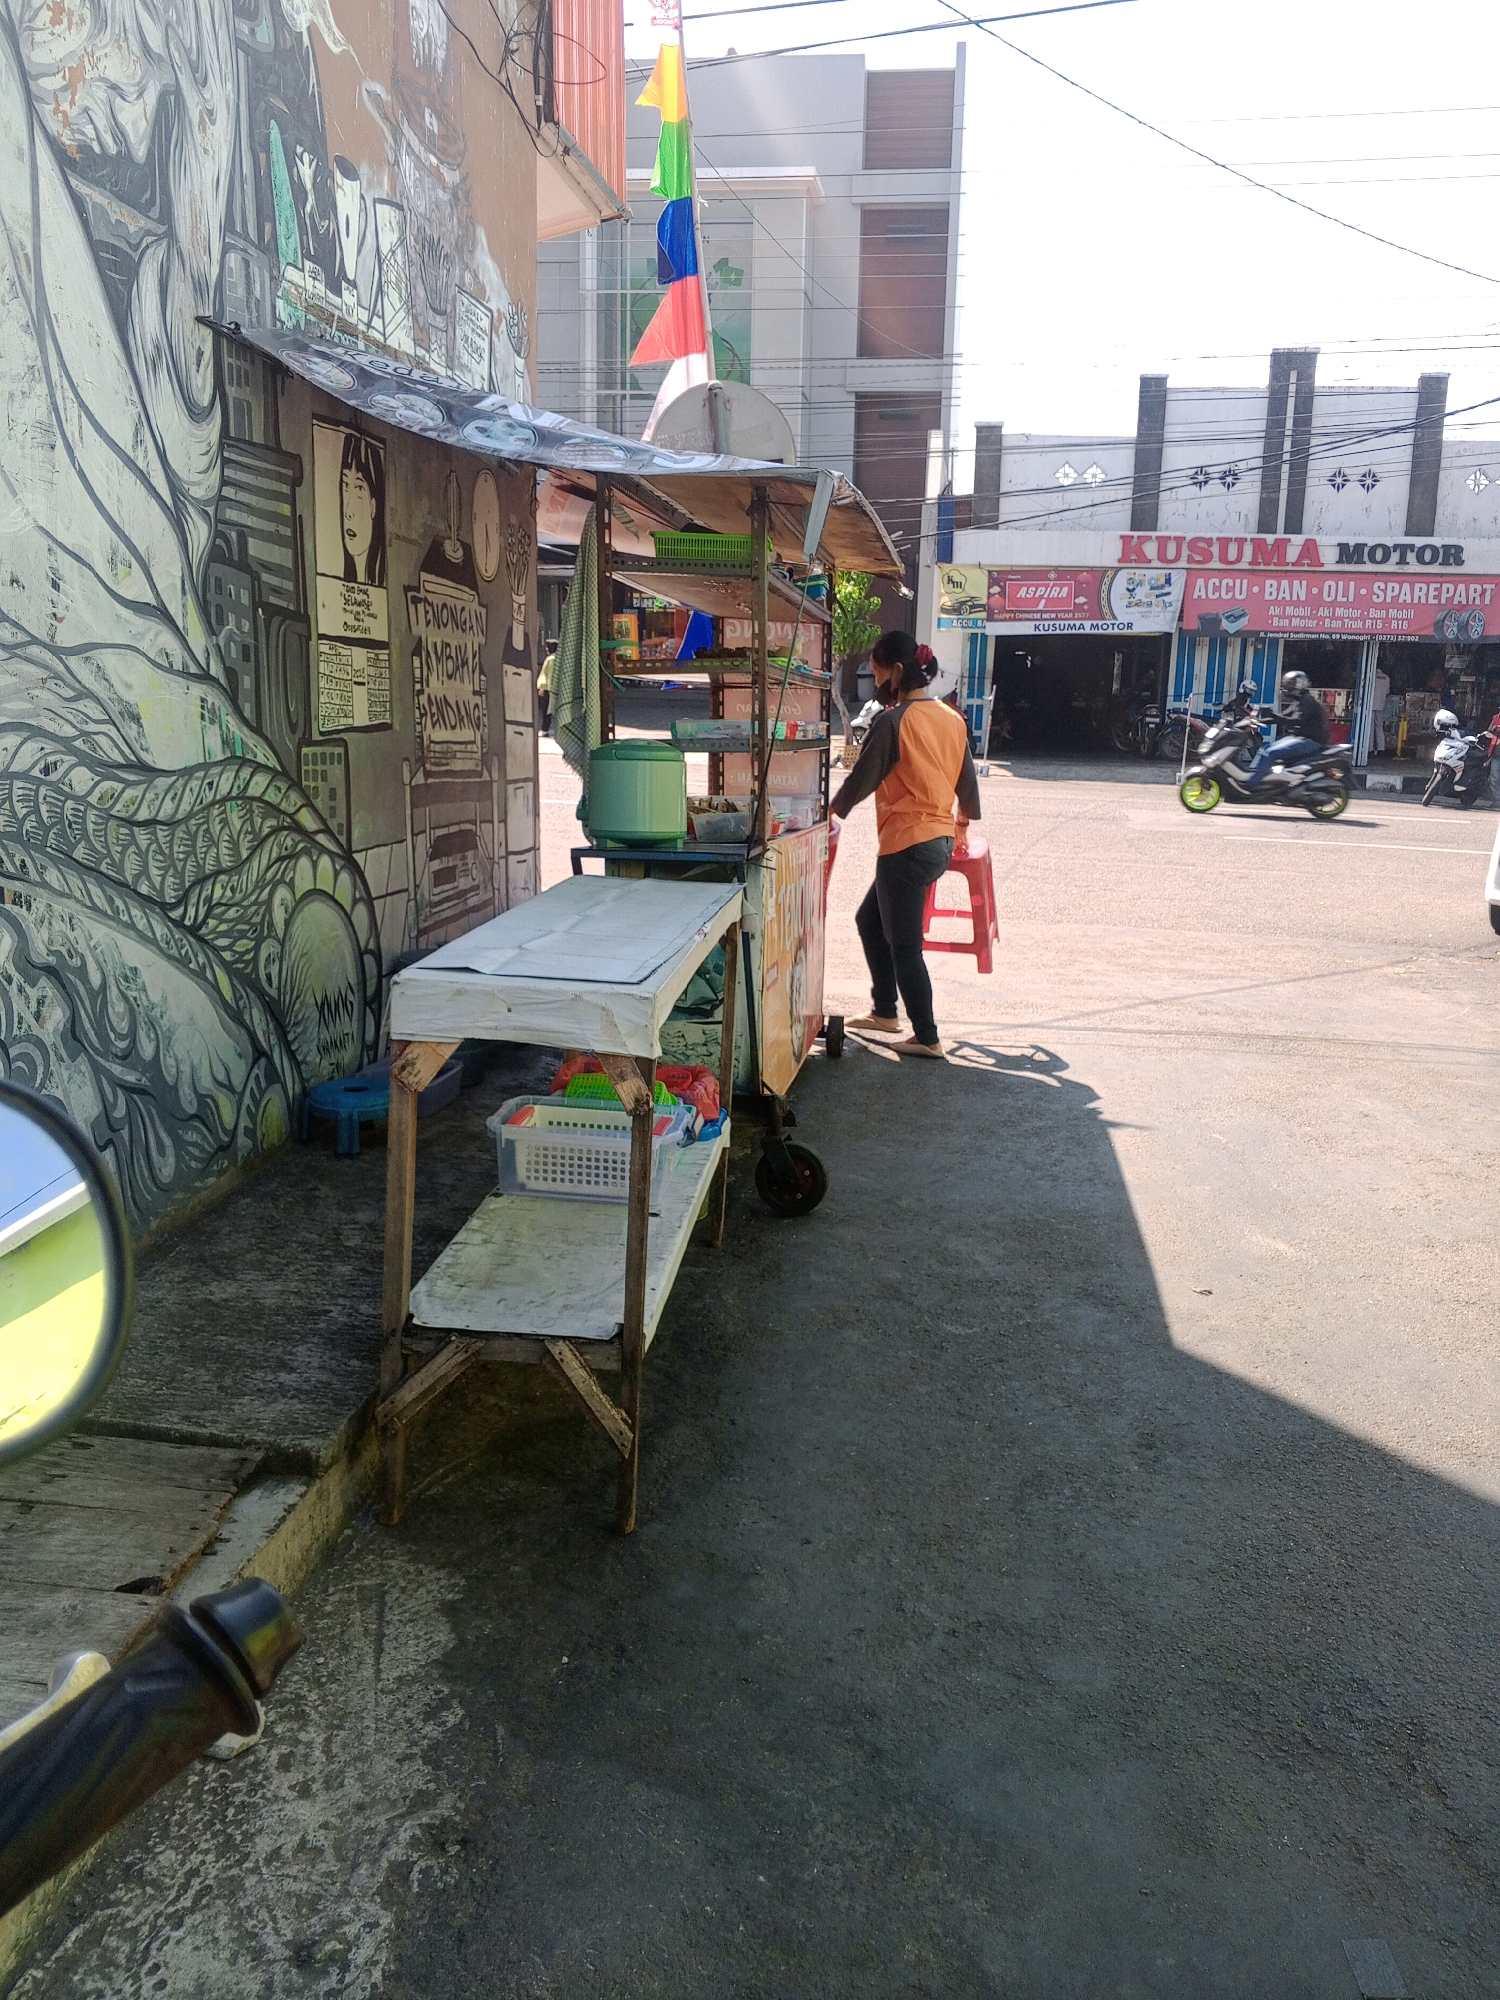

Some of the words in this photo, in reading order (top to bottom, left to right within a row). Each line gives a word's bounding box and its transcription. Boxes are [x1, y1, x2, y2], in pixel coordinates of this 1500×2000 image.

[1118, 534, 1324, 568] KUSUMA
[1336, 542, 1465, 567] MOTOR
[1016, 583, 1069, 600] ASPIRA
[1193, 578, 1248, 601] ACCU
[1264, 579, 1307, 602] BAN
[1322, 580, 1355, 603] OLI
[1371, 581, 1496, 605] SPAREPART
[1268, 606, 1283, 616] Aki
[1285, 606, 1311, 617] Mobil
[1317, 607, 1333, 617] Aki
[1335, 607, 1362, 618] Motor
[1369, 608, 1386, 618] Ban
[1388, 608, 1414, 619] Mobil
[1034, 623, 1085, 632] KUSUMA
[1089, 622, 1134, 631] MOTOR
[1272, 617, 1289, 627] Ban
[1291, 617, 1317, 628] Motor
[1324, 618, 1342, 629] Ban
[1344, 619, 1363, 629] Truk
[1365, 619, 1383, 629] R15
[1391, 620, 1409, 630] R16
[1290, 632, 1319, 640] Sudirman
[1341, 633, 1371, 641] Wonogiri
